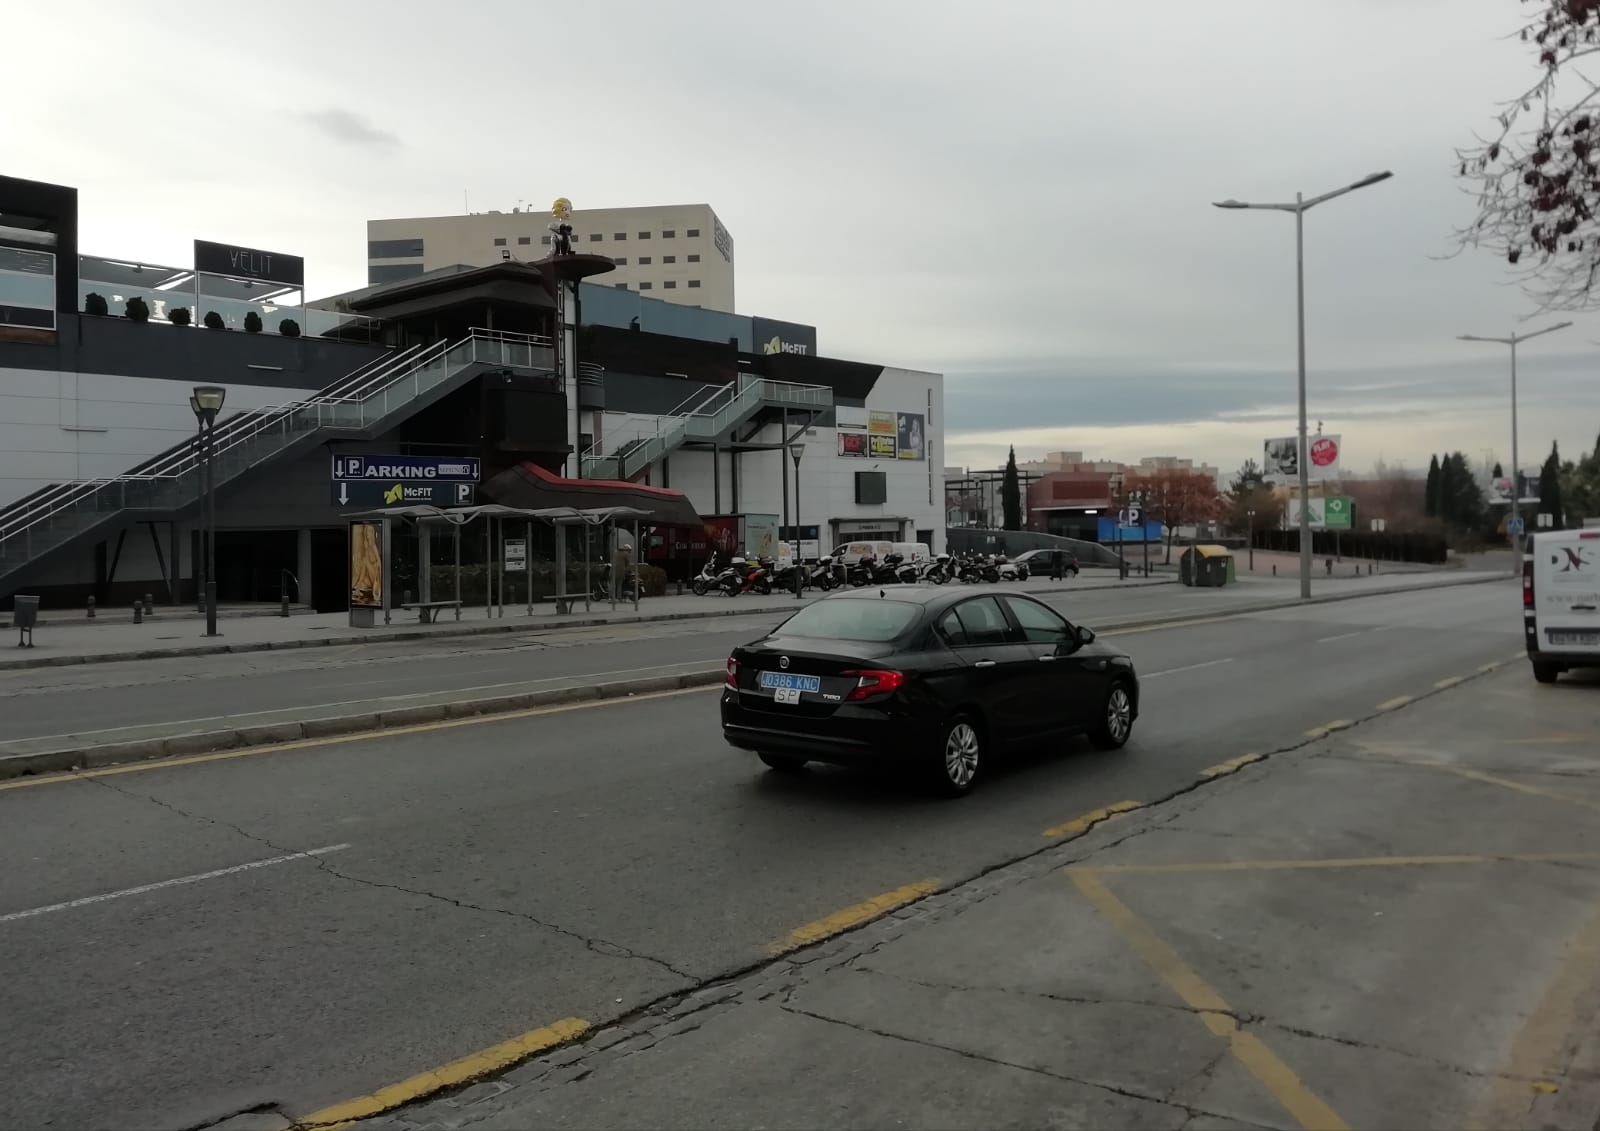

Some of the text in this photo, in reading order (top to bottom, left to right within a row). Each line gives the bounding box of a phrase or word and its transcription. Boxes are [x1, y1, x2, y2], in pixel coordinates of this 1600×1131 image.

[229, 250, 272, 274] VELIT
[781, 341, 807, 355] McFIT
[404, 484, 470, 500] McFIT P
[1128, 509, 1139, 526] P
[766, 674, 818, 690] 0386 KNC
